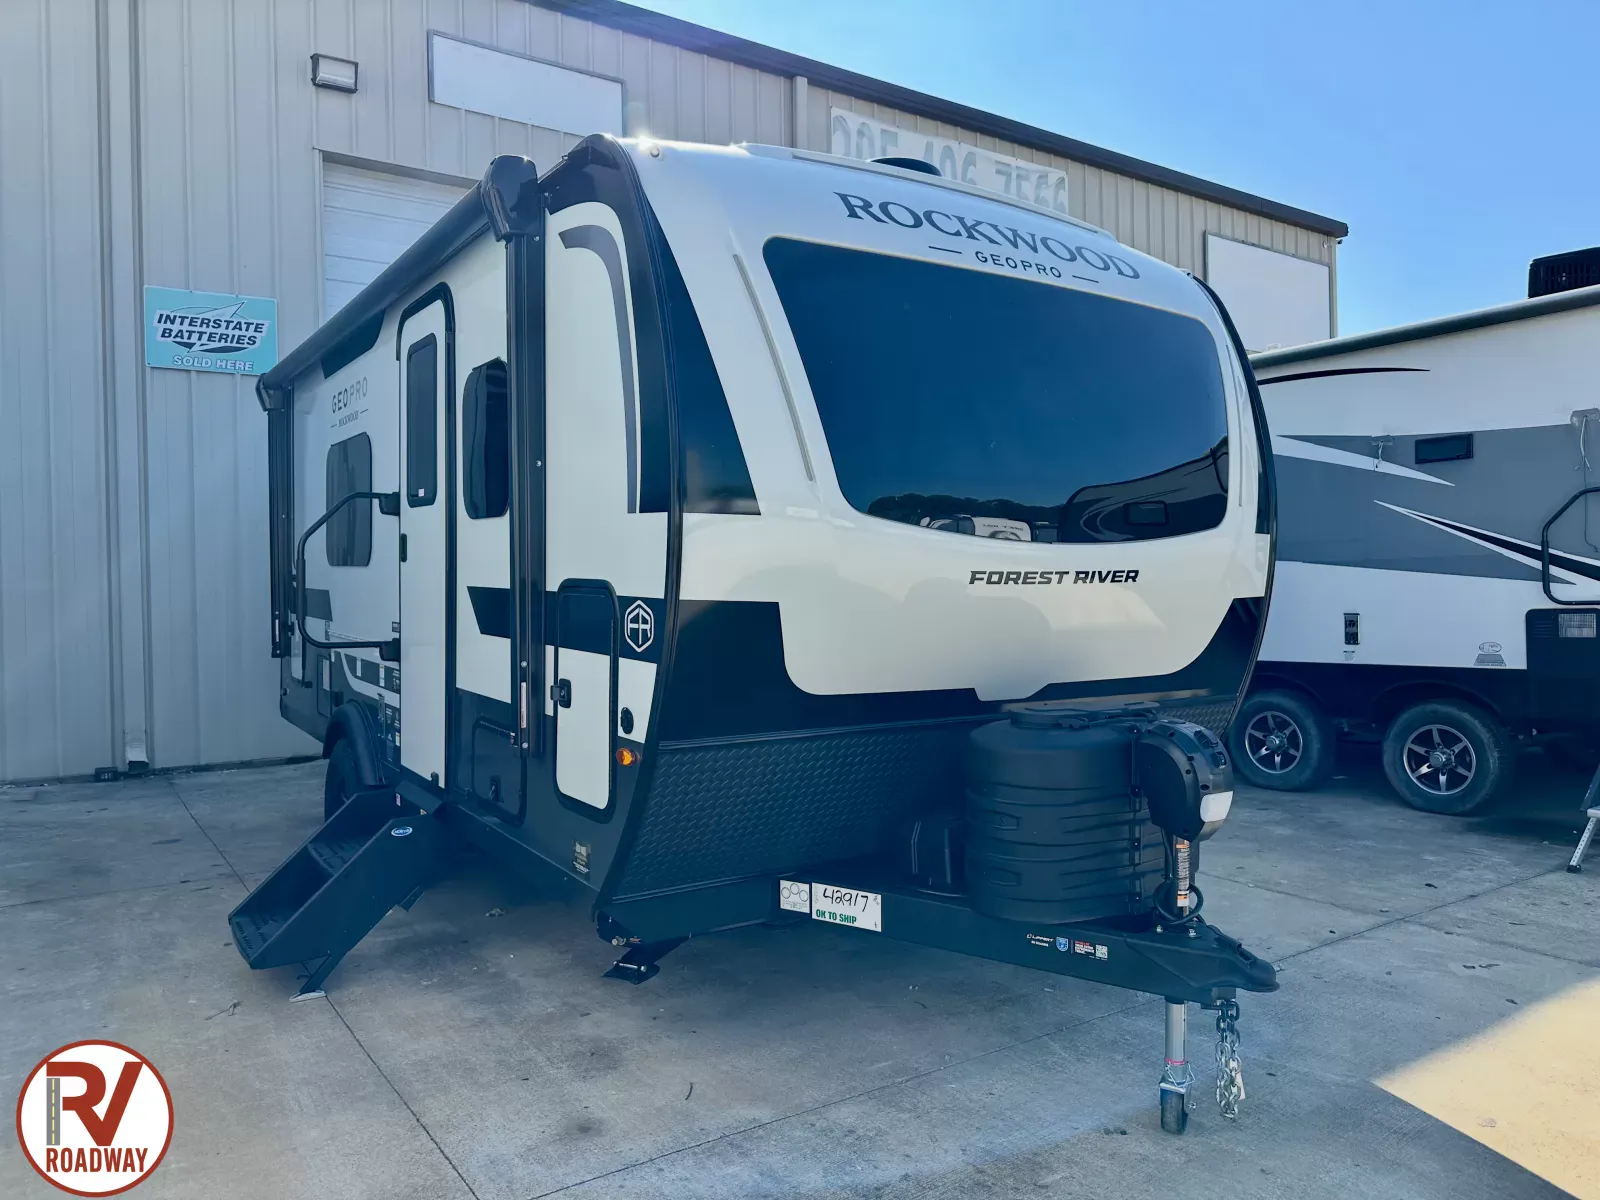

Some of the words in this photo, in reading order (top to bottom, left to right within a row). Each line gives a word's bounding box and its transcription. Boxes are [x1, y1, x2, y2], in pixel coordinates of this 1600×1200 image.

[833, 191, 1140, 280] ROCKWOOD
[974, 251, 1062, 279] GEOPRO
[157, 313, 265, 334] INTERSTATE
[160, 327, 258, 346] BATTERIES
[173, 355, 212, 368] SOLD
[216, 359, 254, 371] HERE
[332, 376, 368, 414] GEOPRO
[968, 570, 1070, 585] FOREST
[1073, 569, 1140, 584] RIVER
[822, 887, 869, 912] 42917
[815, 909, 827, 919] OK
[828, 911, 837, 921] TO
[839, 913, 857, 925] SHIP
